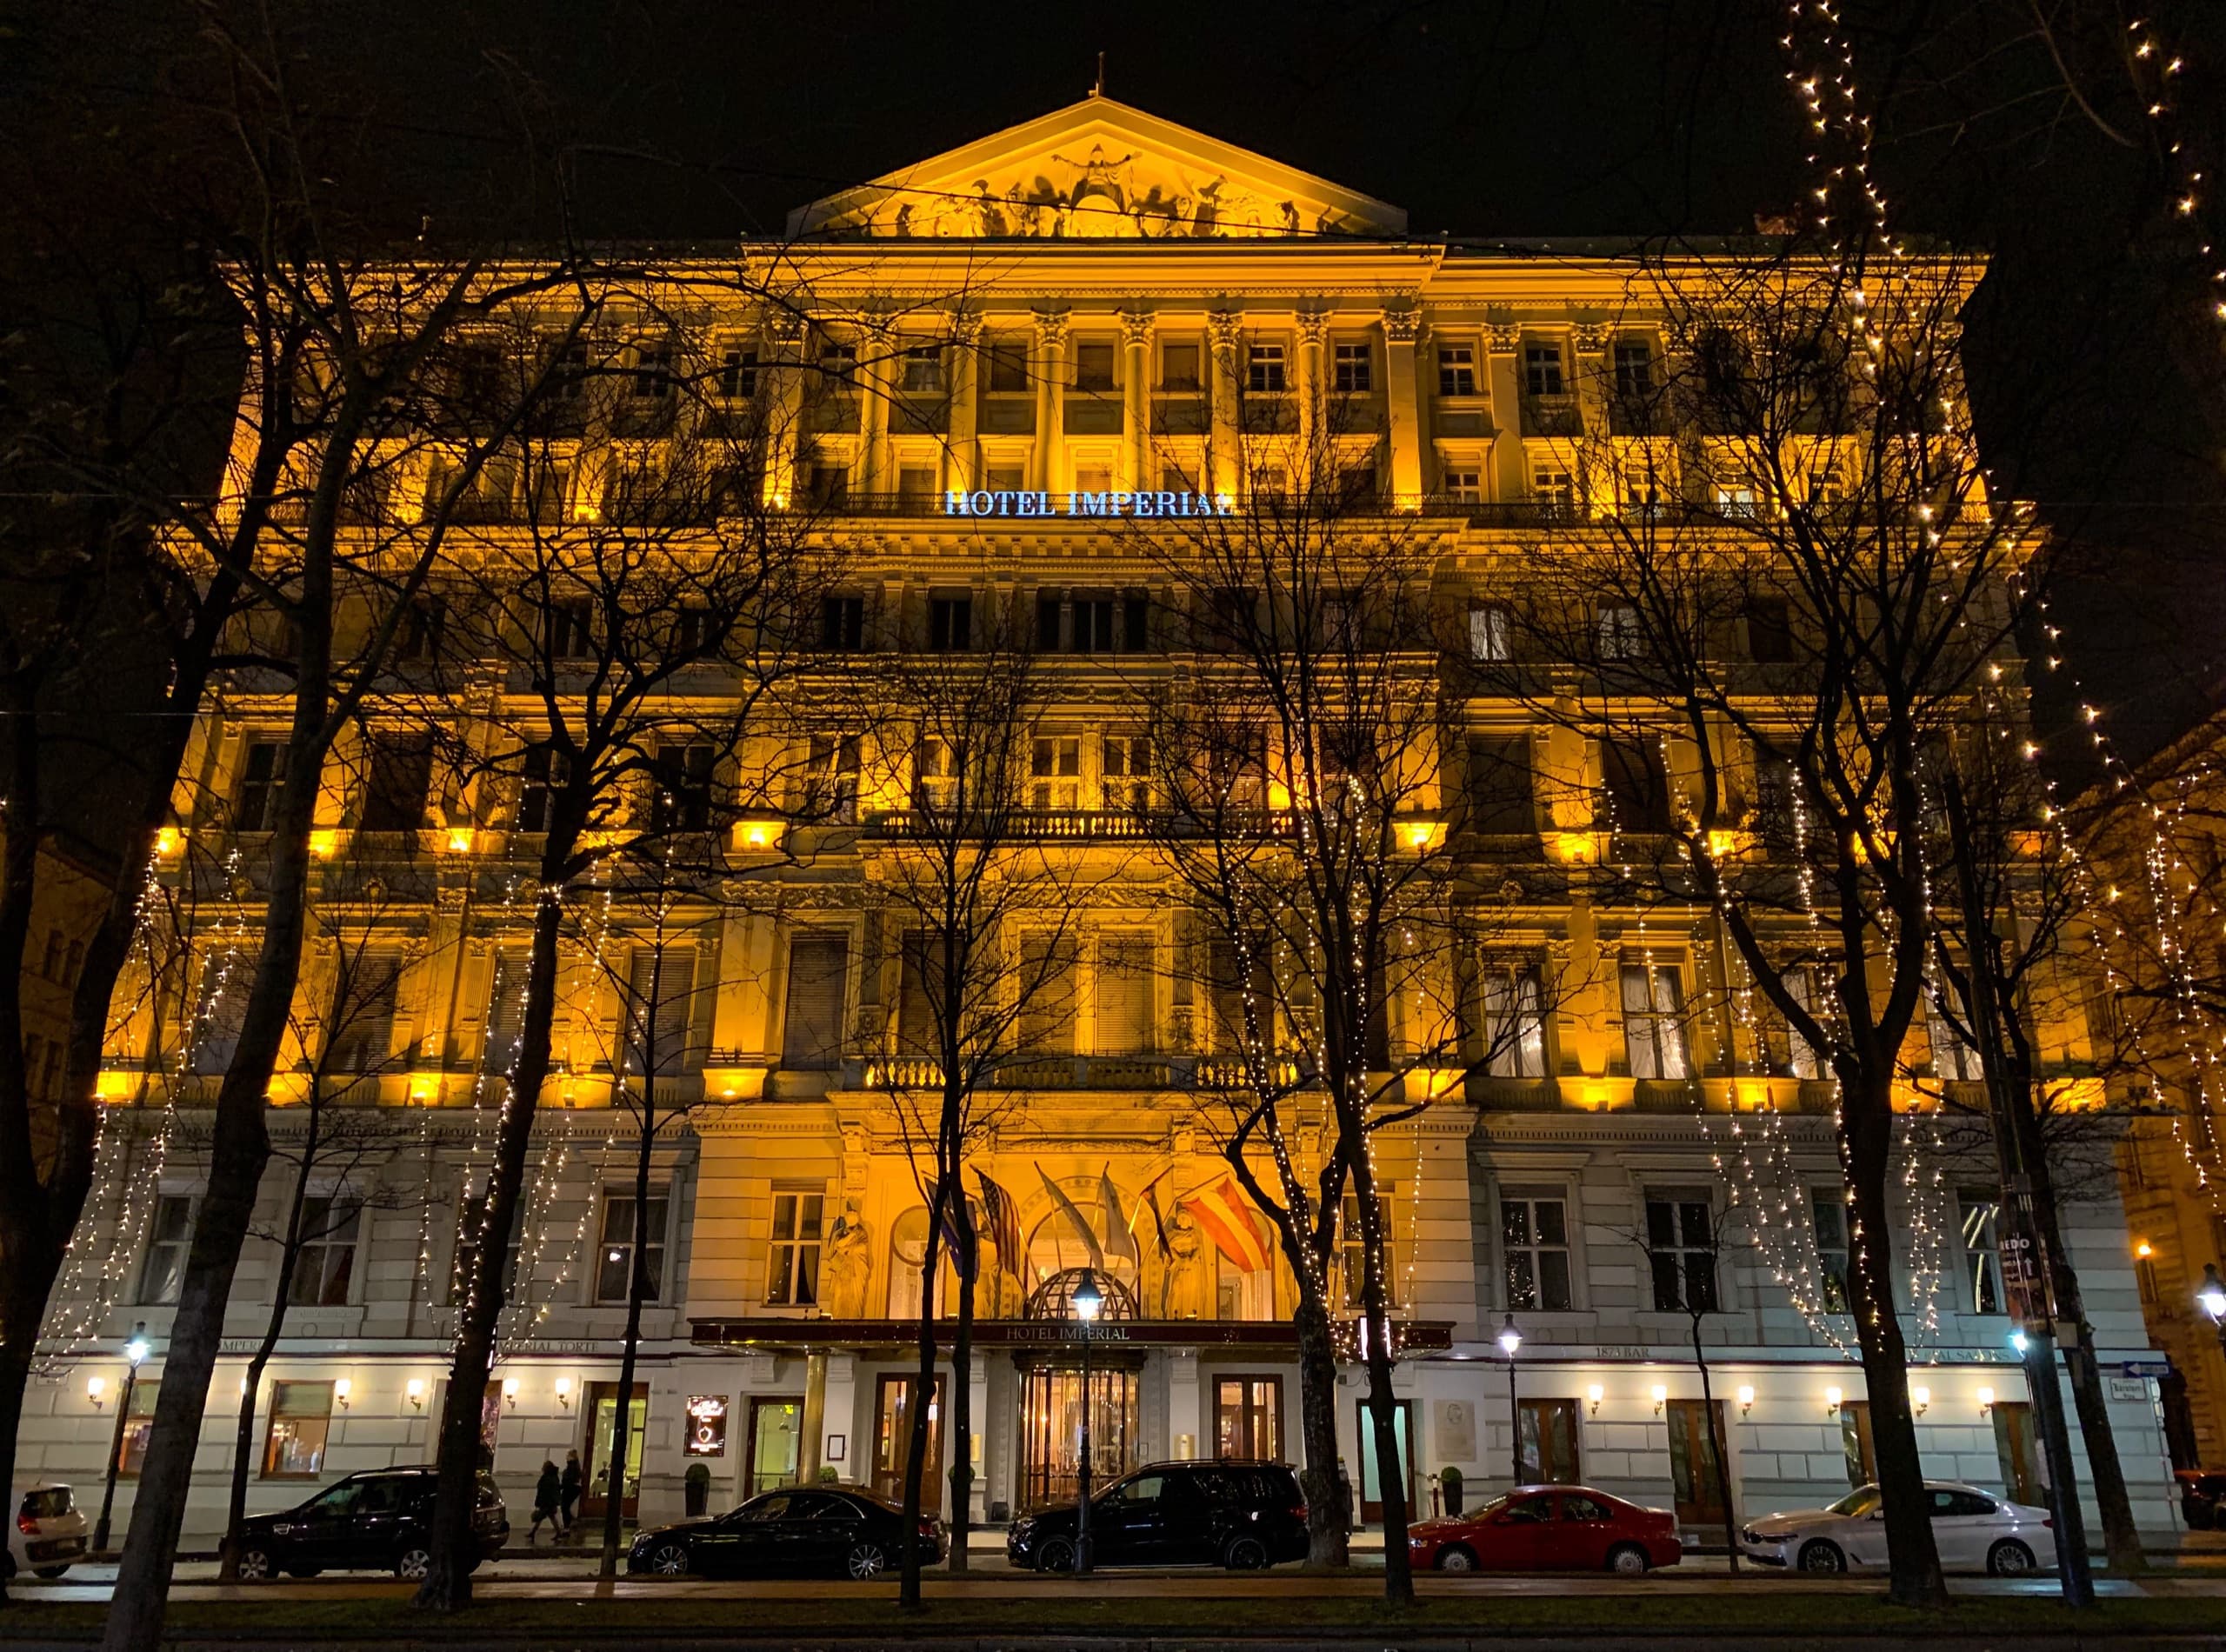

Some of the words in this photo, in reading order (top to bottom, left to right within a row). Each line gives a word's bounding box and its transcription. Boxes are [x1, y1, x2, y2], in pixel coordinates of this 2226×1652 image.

[945, 490, 1056, 516] HOTEL
[1067, 490, 1234, 516] IMPERIAL
[1007, 1328, 1056, 1341] HOTEL
[1059, 1328, 1130, 1341] IMPERIAL
[558, 1342, 599, 1353] TORTE
[1596, 1347, 1621, 1357] 1873
[1624, 1347, 1650, 1357] BAR
